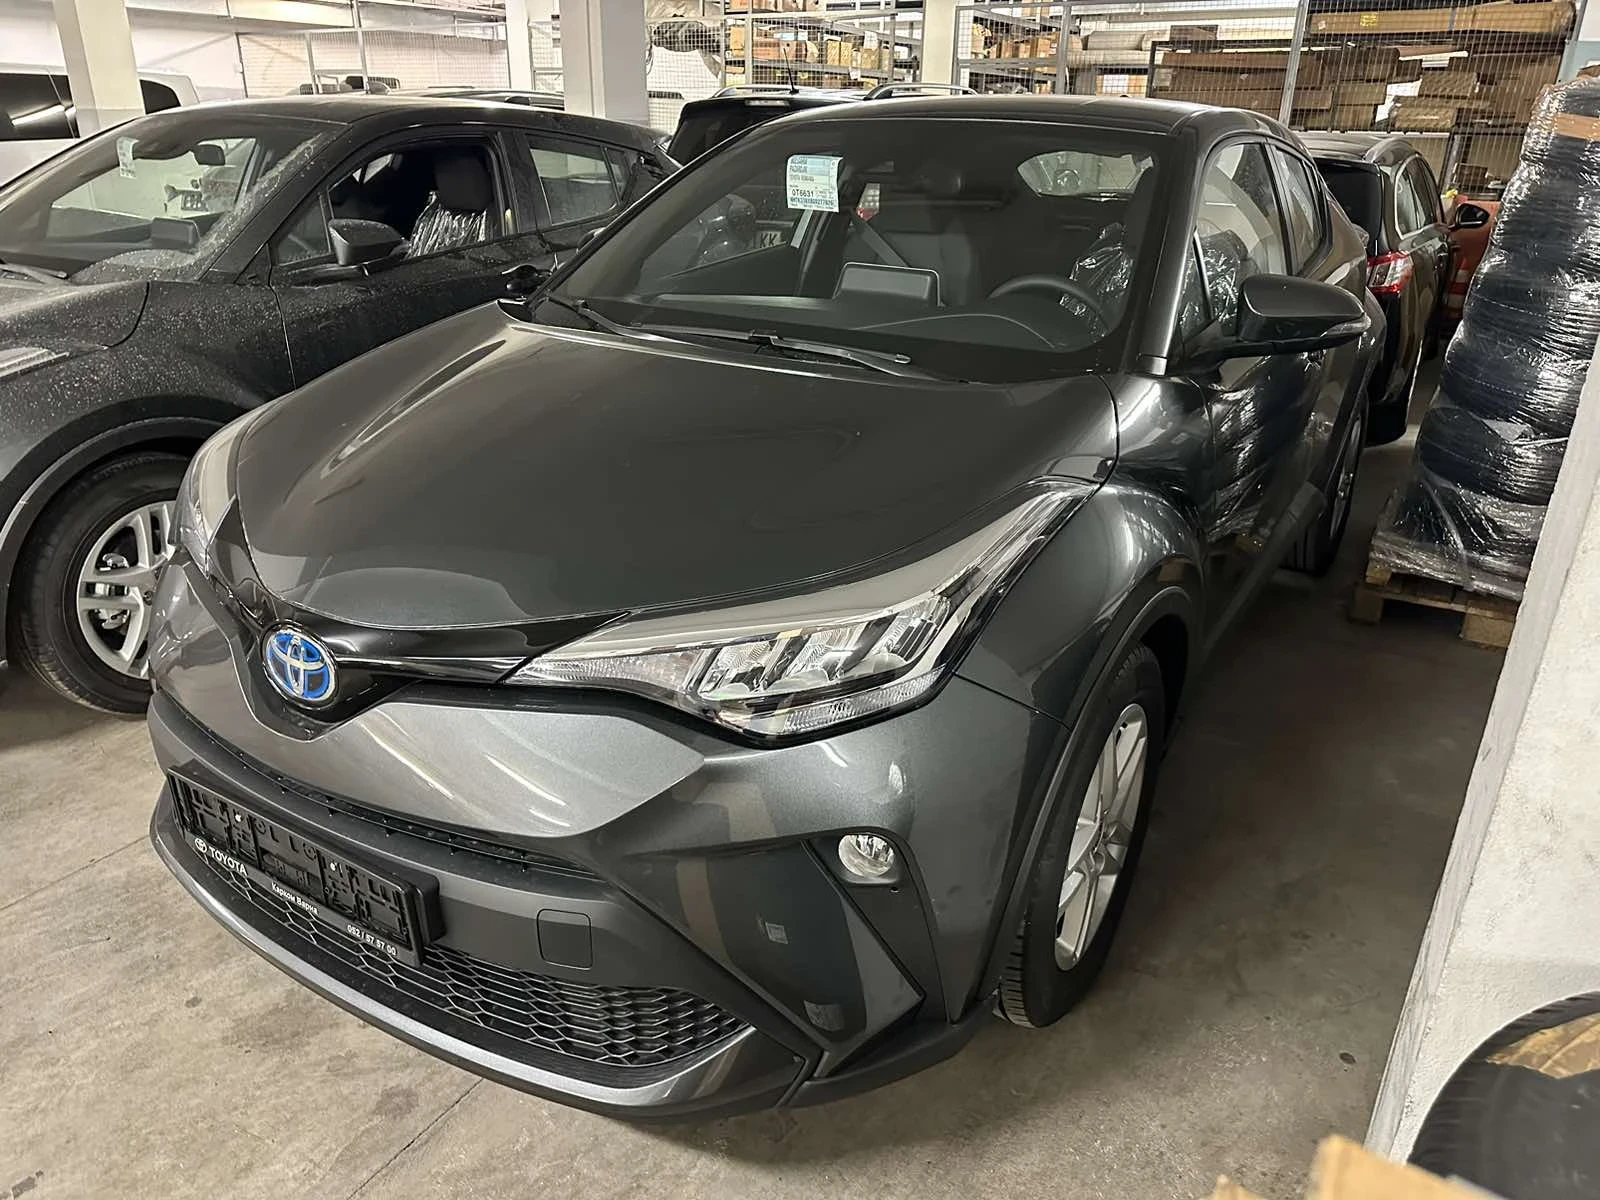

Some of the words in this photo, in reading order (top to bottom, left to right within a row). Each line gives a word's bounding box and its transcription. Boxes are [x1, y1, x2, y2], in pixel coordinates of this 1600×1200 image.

[209, 846, 248, 877] TOYOTA
[271, 881, 296, 903] Карком
[296, 897, 319, 915] Варна
[347, 924, 360, 937] 052
[366, 934, 375, 944] 57
